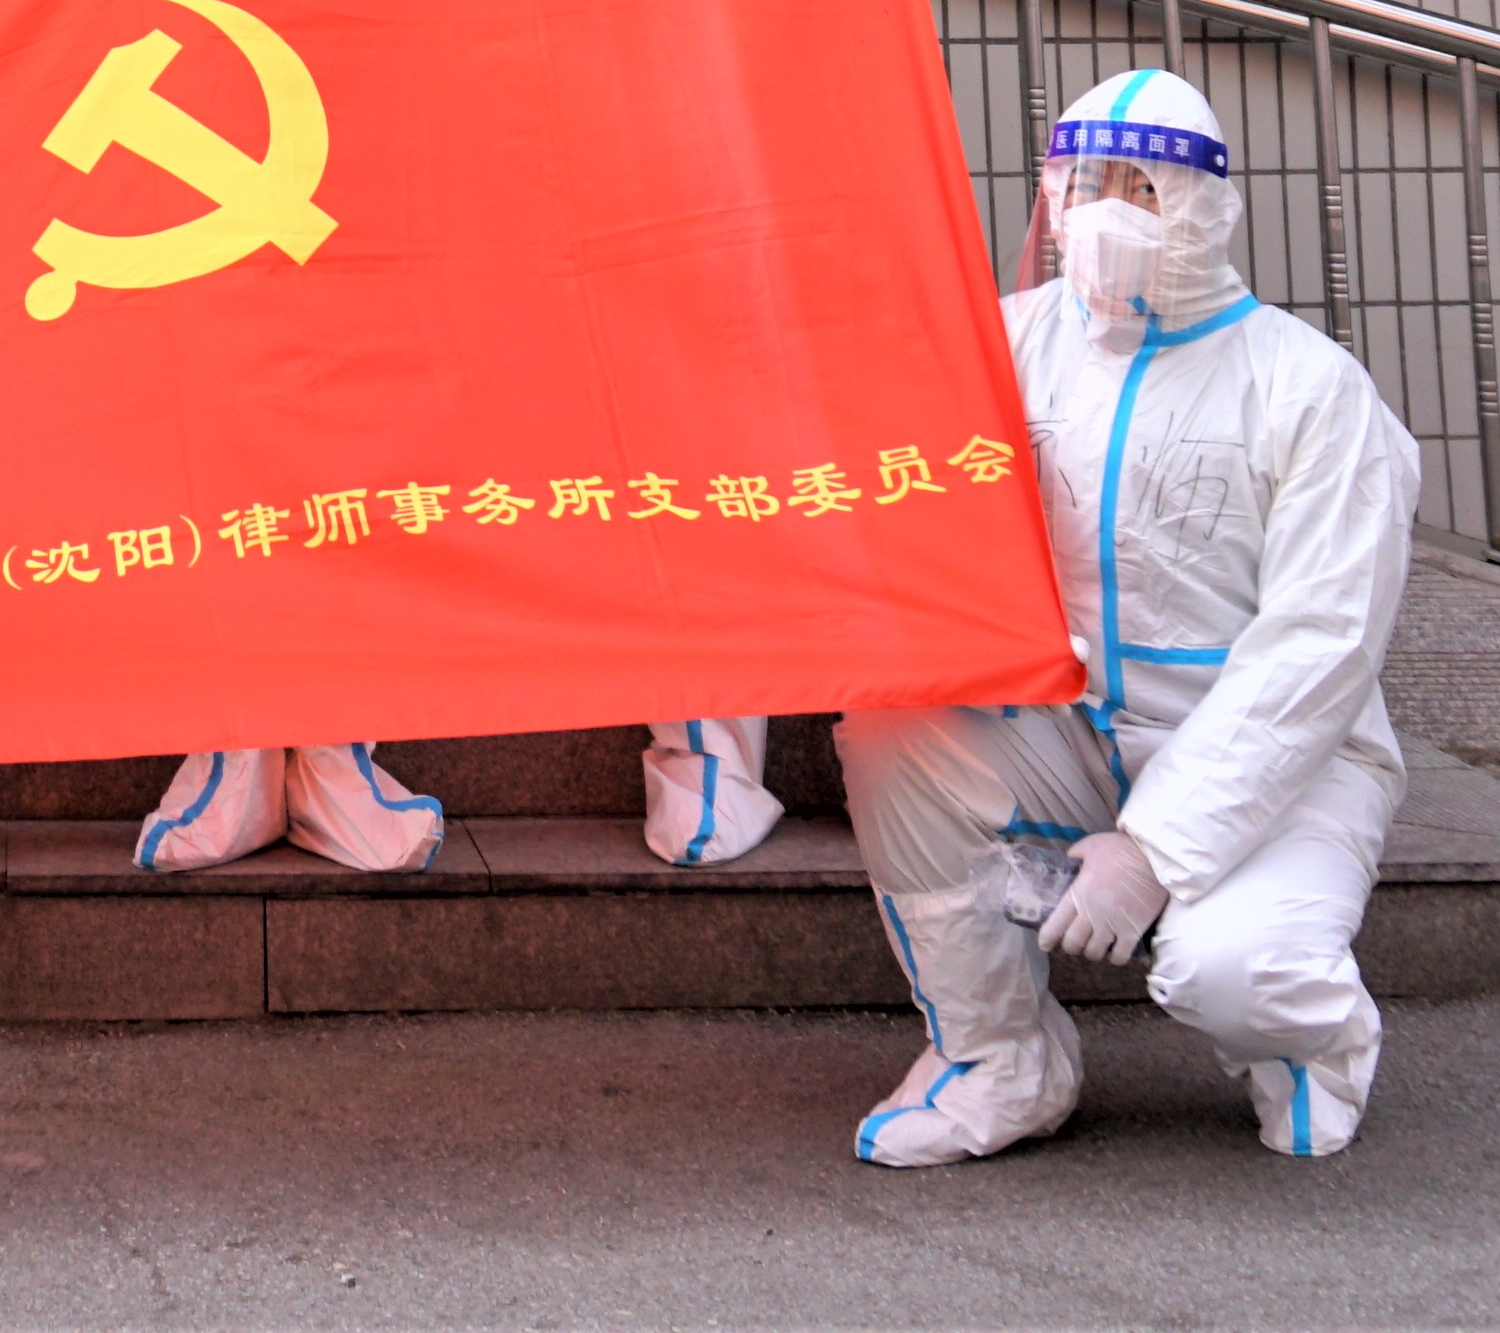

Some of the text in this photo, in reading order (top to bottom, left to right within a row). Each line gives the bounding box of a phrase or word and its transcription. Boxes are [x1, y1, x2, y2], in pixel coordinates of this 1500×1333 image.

[1054, 129, 1191, 159] 医用隔离面罩
